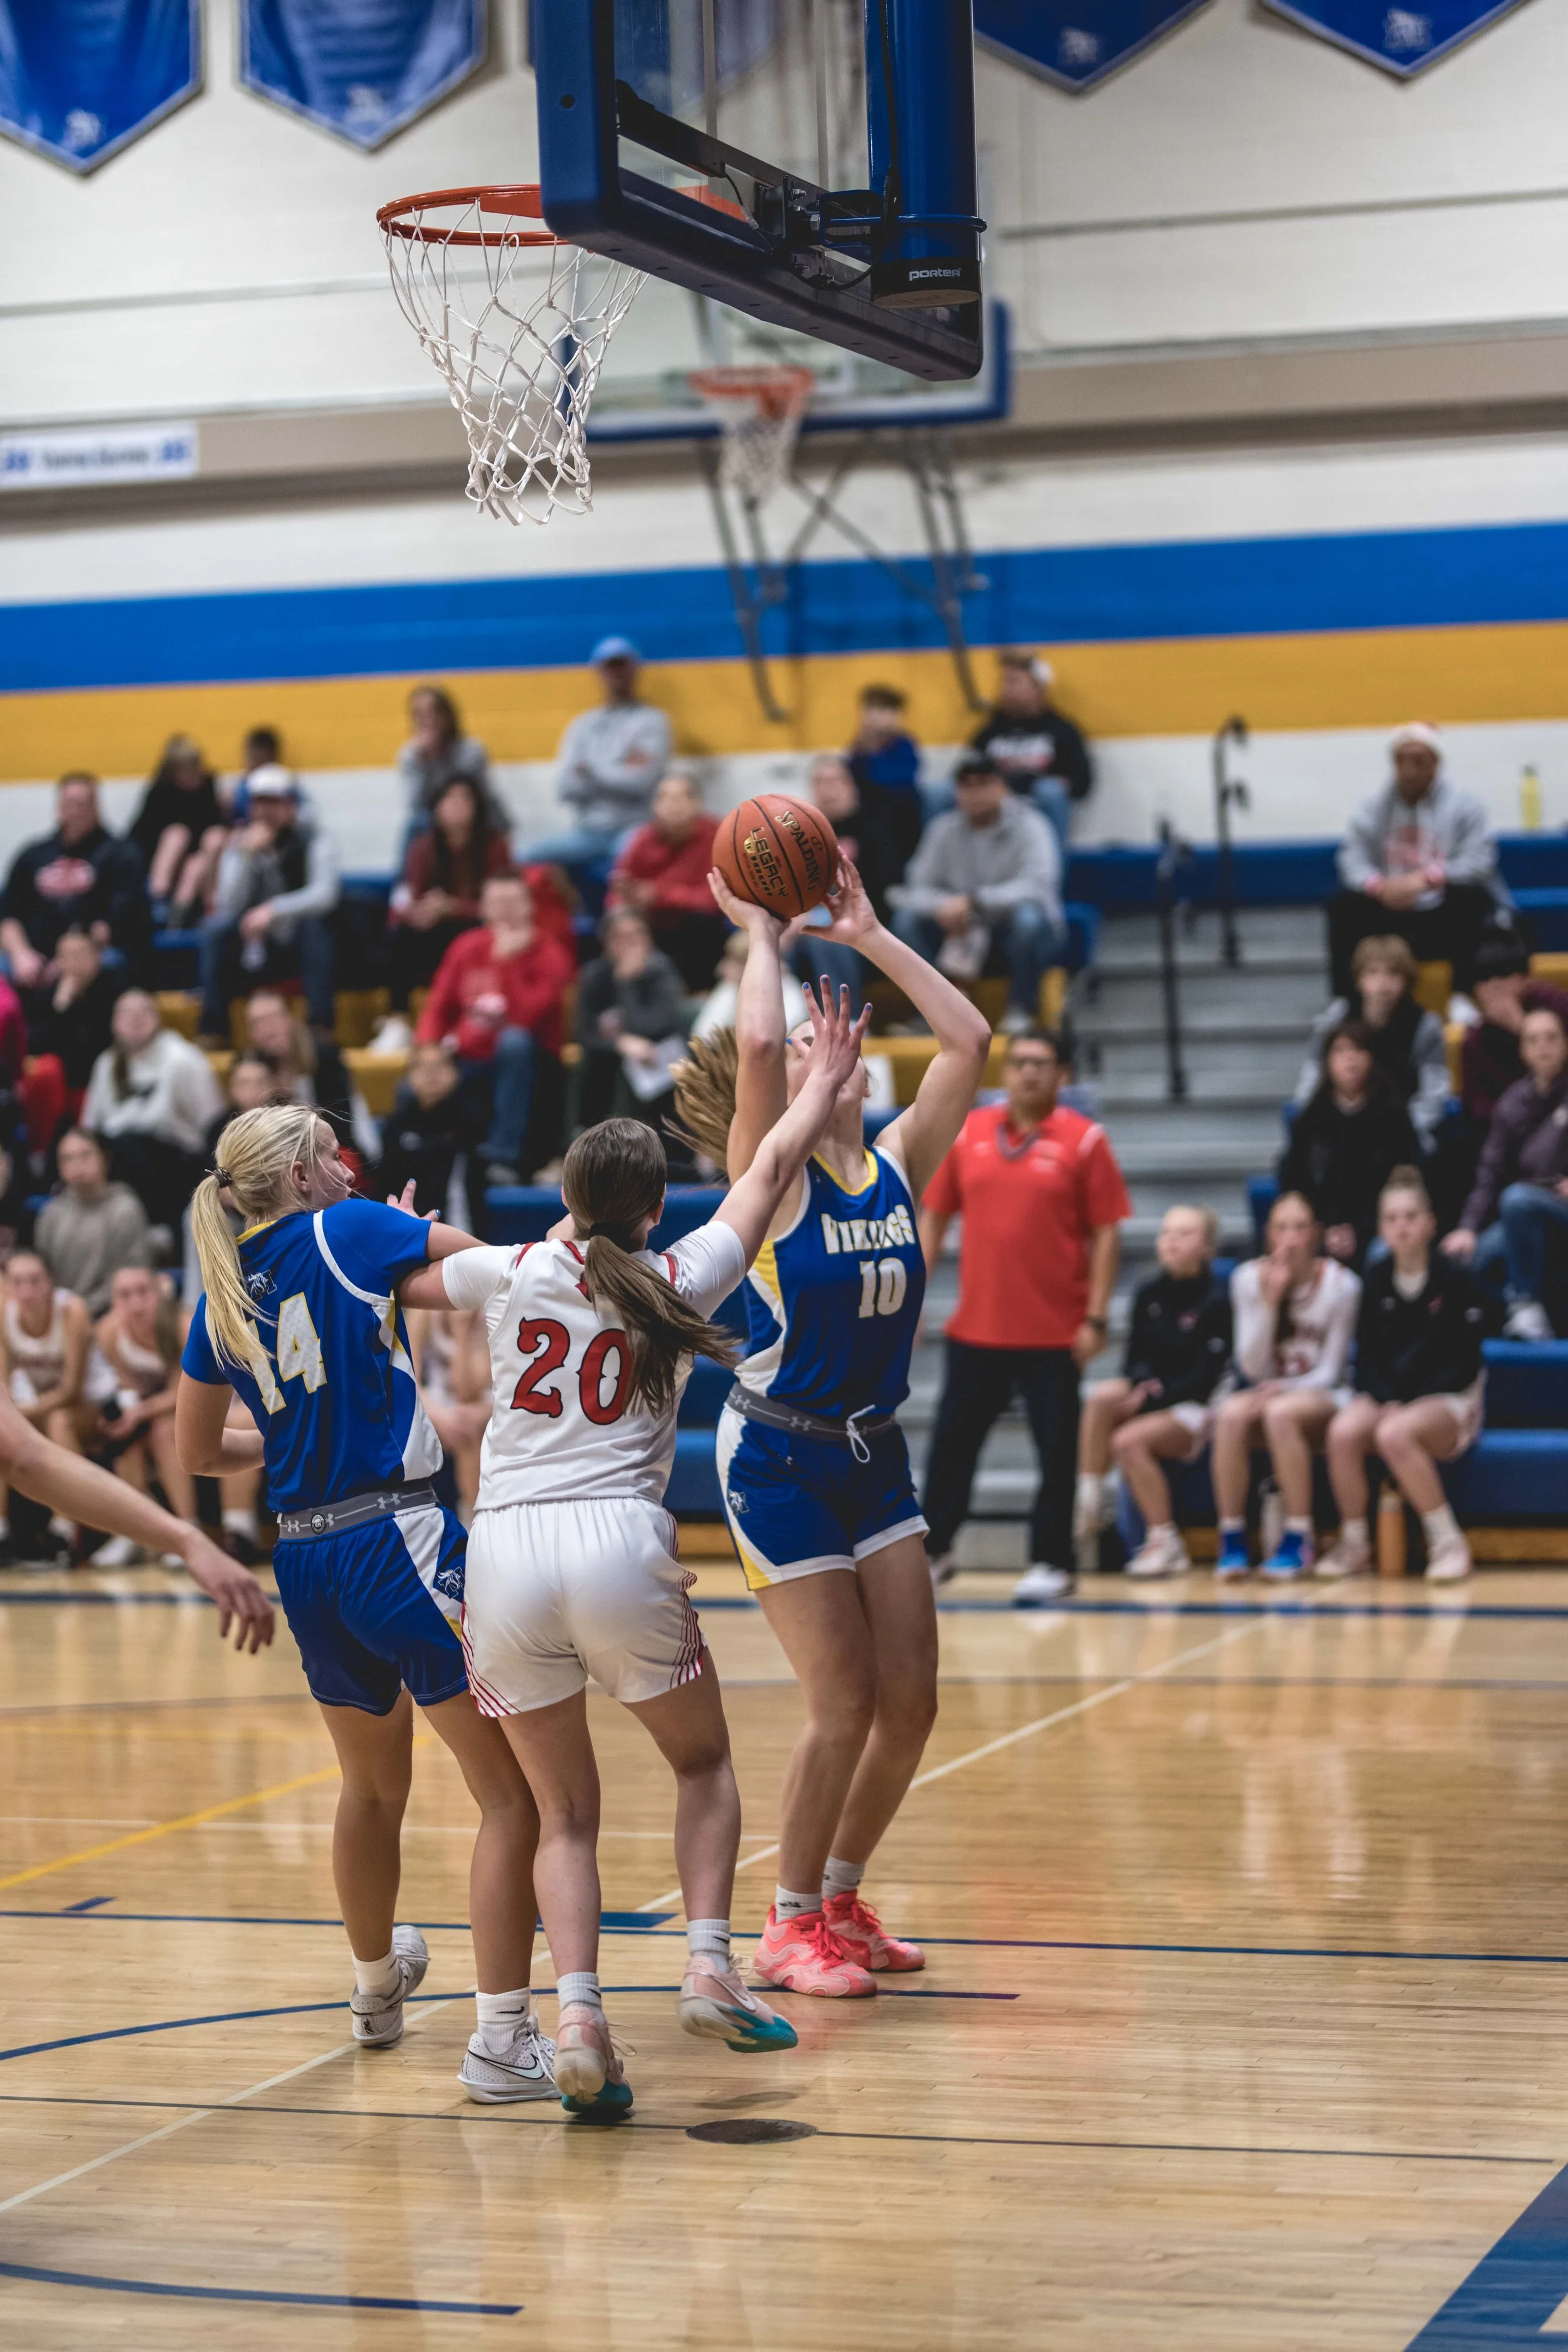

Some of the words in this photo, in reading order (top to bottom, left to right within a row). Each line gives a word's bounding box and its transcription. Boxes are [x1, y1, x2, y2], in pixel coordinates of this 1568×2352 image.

[750, 826, 790, 897] LEGACY
[821, 1204, 916, 1254] VIKINGS
[859, 1257, 907, 1318] 10
[246, 1291, 327, 1416] 14
[510, 1316, 633, 1426] 20
